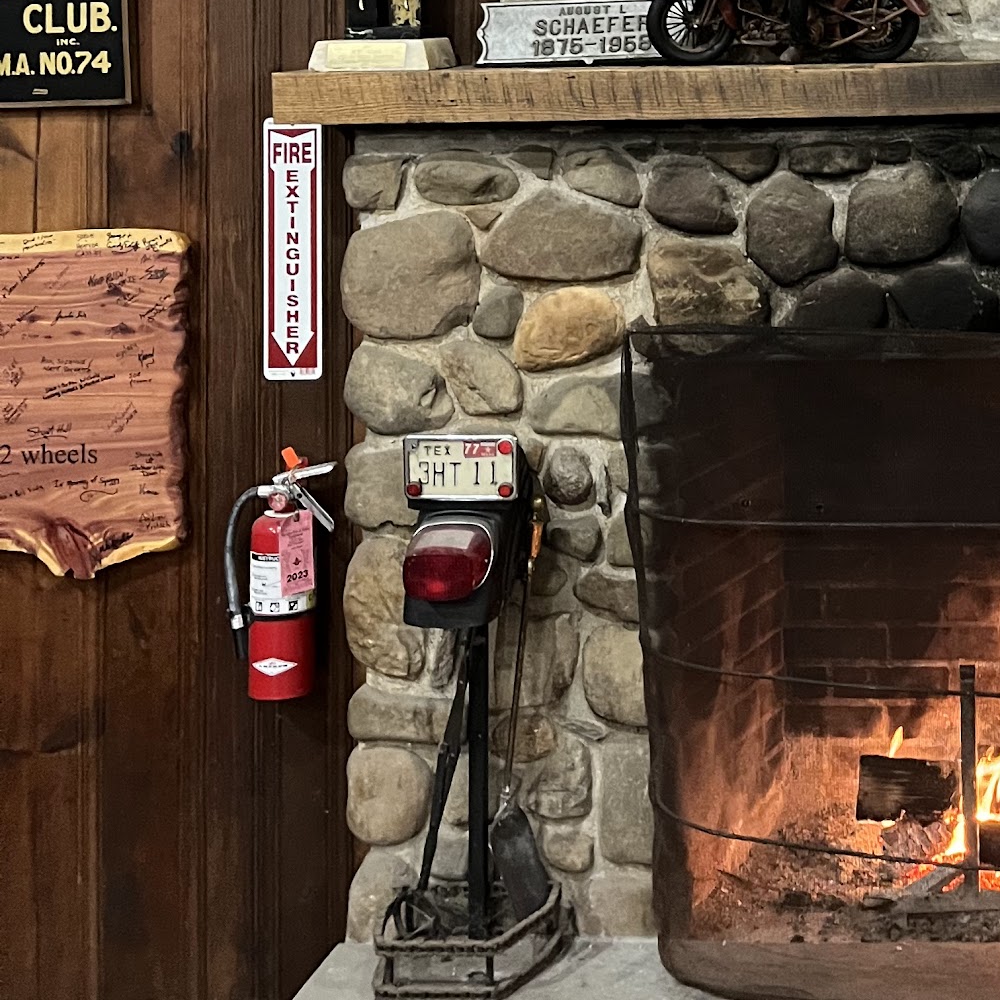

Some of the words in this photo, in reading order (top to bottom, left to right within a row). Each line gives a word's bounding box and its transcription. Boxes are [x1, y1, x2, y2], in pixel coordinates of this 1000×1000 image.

[23, 1, 118, 34] CLUB.
[559, 5, 611, 16] AUGUST
[619, 4, 627, 14] L
[56, 38, 80, 47] INC.
[39, 50, 112, 75] NO.74
[273, 142, 312, 164] FIRE
[286, 170, 300, 354] EXTINGUISHER
[0, 444, 12, 465] 2
[22, 443, 98, 465] wheels
[424, 446, 451, 456] TEX
[464, 443, 480, 455] 77
[419, 462, 461, 487] 3HT
[473, 461, 498, 486] 11
[286, 569, 309, 583] 2023
